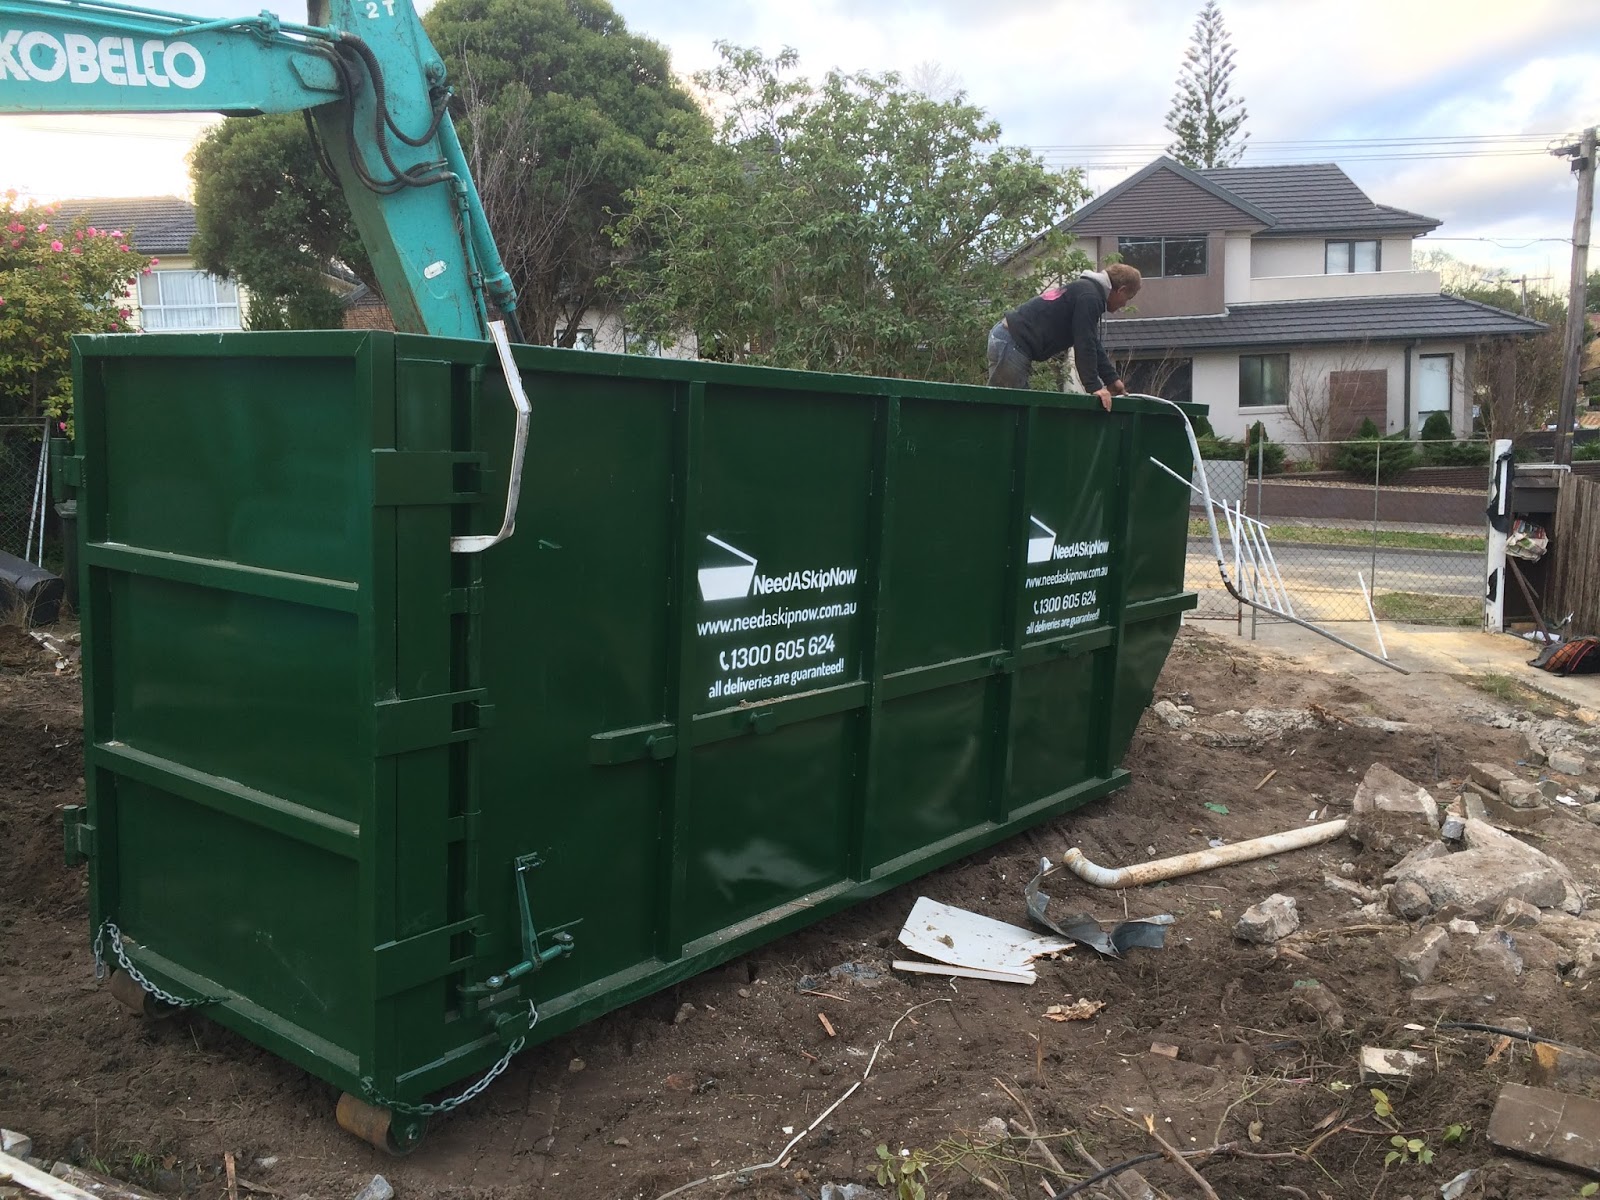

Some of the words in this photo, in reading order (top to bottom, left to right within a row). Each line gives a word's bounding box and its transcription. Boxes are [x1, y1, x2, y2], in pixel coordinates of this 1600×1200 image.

[0, 29, 206, 89] KOBELCO
[1053, 540, 1109, 559] NeedASkipNow
[753, 567, 857, 595] NeedASkipNow
[1039, 596, 1061, 615] 1300
[1062, 592, 1080, 610] 605
[1081, 590, 1097, 606] 624
[697, 602, 857, 637] www.needaskipnow.com.au
[1025, 621, 1035, 635] all
[1034, 617, 1060, 633] deliveries
[1060, 618, 1070, 628] are
[1069, 608, 1100, 628] guaranteed!
[730, 644, 771, 670] 1300
[774, 638, 805, 662] 605
[807, 633, 836, 656] 624
[708, 681, 722, 698] all
[723, 674, 772, 696] deliveries
[773, 674, 790, 686] are
[790, 658, 845, 686] guaranteed!
